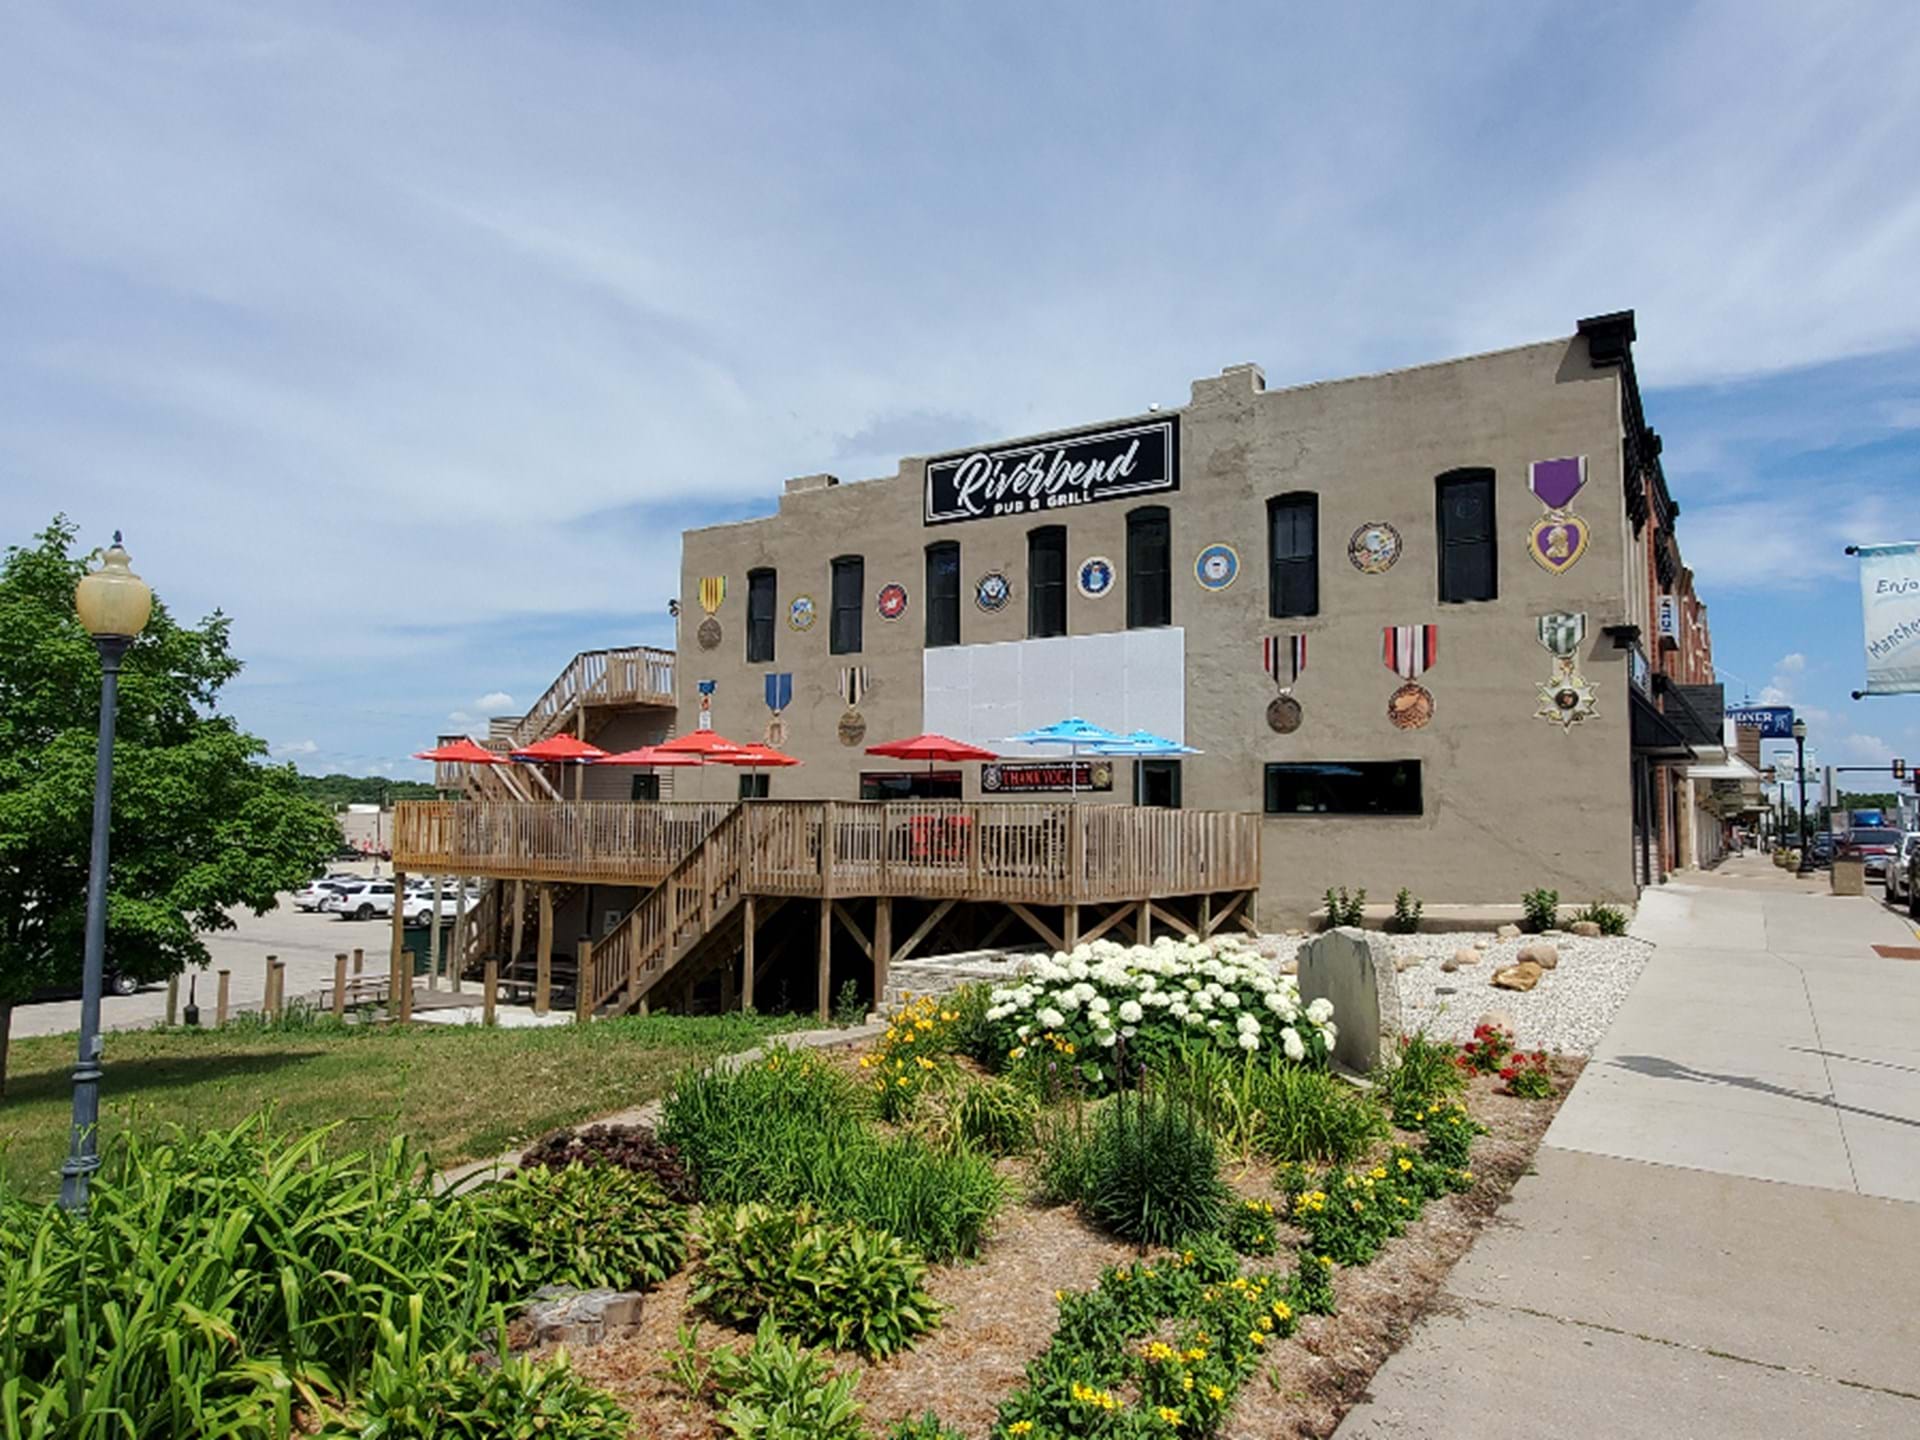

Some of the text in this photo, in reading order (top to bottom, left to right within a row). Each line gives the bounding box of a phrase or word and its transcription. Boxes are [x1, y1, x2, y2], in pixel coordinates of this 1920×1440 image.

[953, 439, 1140, 515] Riverbend
[993, 501, 1024, 515] PUB
[1047, 490, 1093, 508] GRILL
[1867, 618, 1920, 660] Manche
[1002, 771, 1040, 785] THANK
